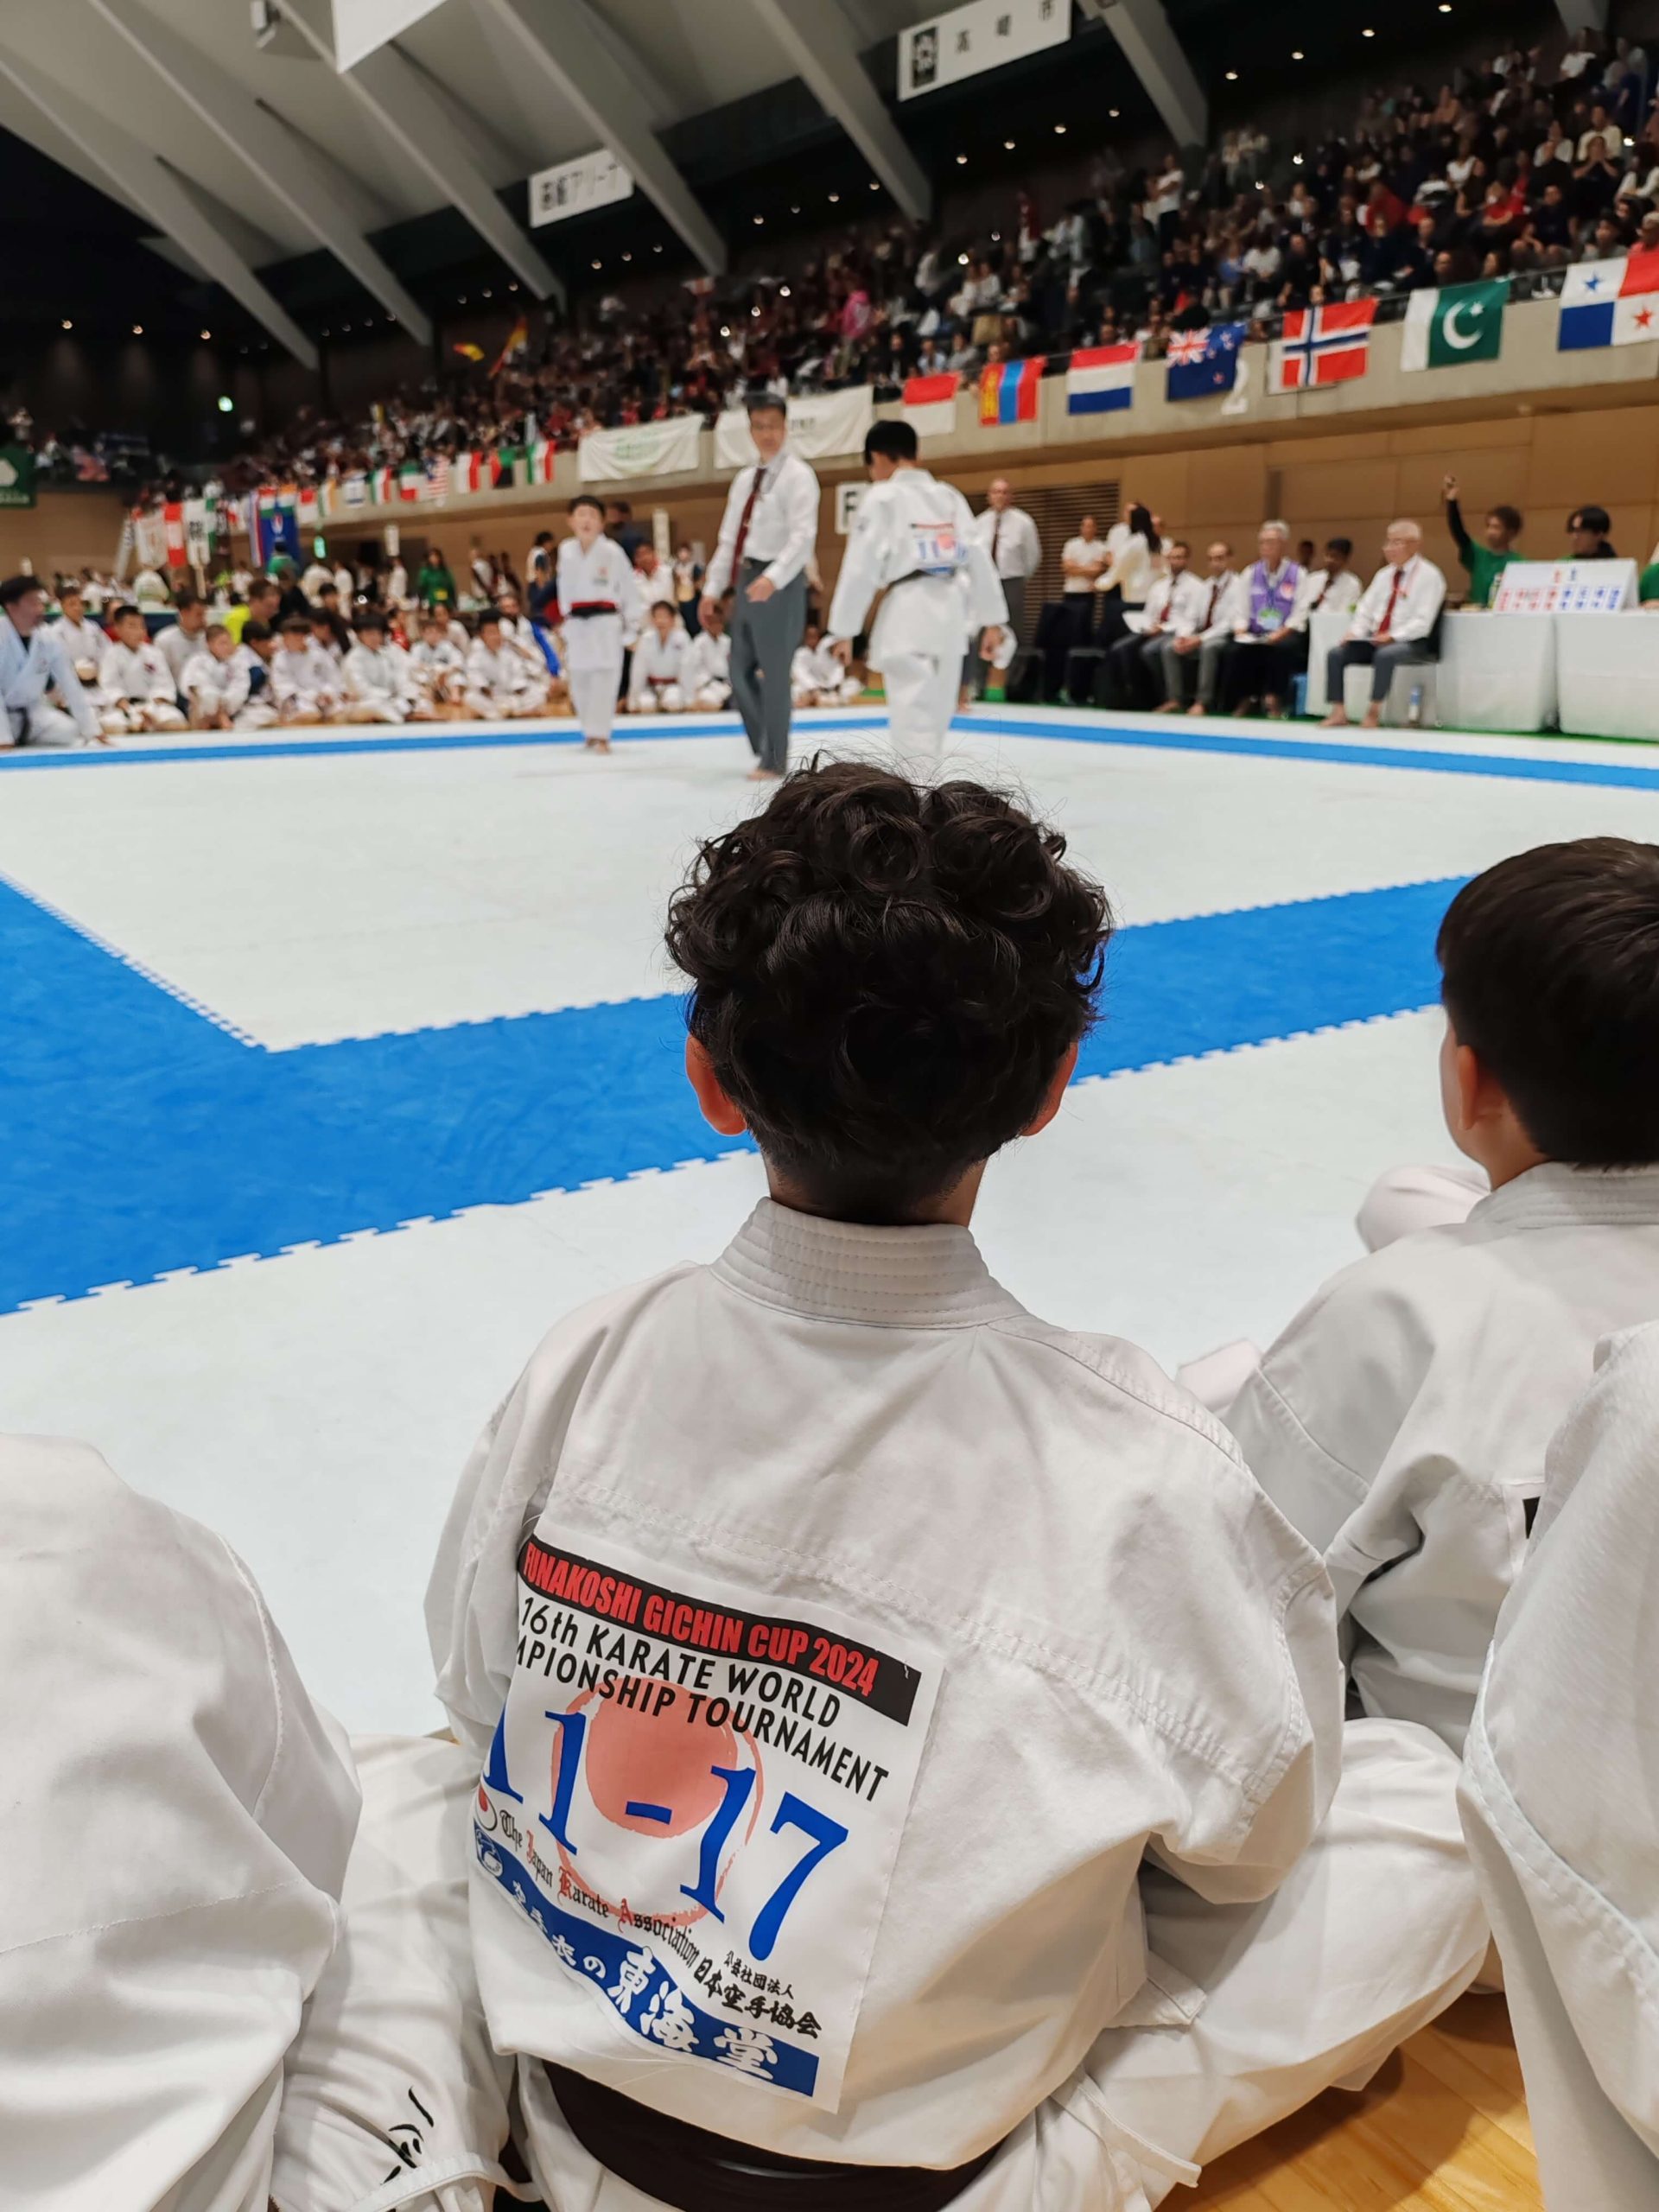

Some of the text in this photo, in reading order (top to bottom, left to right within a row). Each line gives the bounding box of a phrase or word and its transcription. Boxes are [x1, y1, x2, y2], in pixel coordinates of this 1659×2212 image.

[521, 1597, 841, 1728] 16th KARATE WORLD
[524, 1542, 880, 1698] FUNAKOSHI GICHIN CUP 2024
[687, 1693, 889, 1802] TOURNAMENT
[499, 1809, 700, 1969] The Japan Karate Association
[693, 1956, 823, 2039] 日本空手協会
